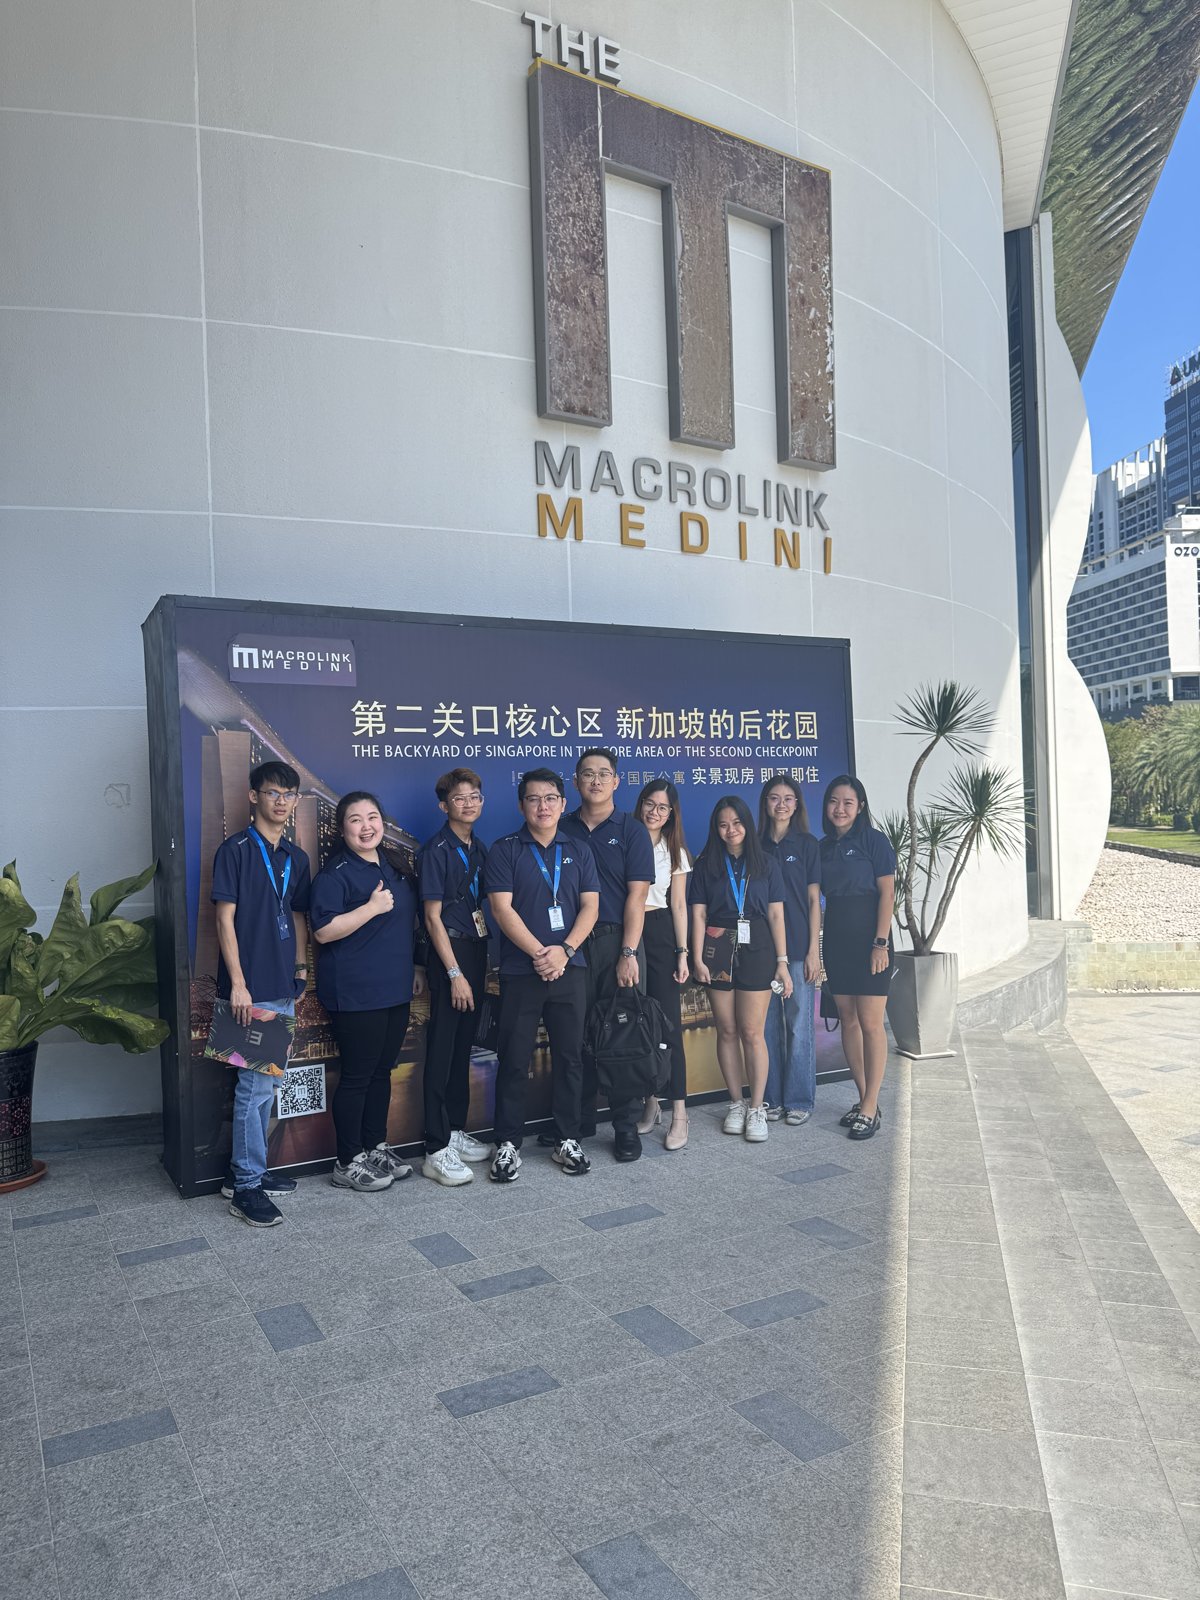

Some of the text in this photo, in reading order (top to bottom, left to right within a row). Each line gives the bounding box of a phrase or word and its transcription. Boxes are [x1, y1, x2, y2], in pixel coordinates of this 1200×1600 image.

[521, 11, 621, 86] THE
[535, 440, 830, 531] MACROLINK
[536, 493, 832, 575] MEDINI
[1174, 546, 1200, 557] OZO
[261, 649, 351, 663] MACROLINK
[262, 659, 352, 673] MEDINI
[350, 700, 818, 741] 第二关口核心区 新加坡的后花园
[351, 744, 380, 758] THE
[384, 744, 460, 758] BACKYARD
[464, 745, 482, 758] OF
[485, 744, 556, 758] SINGAPORE
[560, 745, 573, 758] IN
[602, 745, 632, 758] ORE
[635, 746, 664, 758] AREA
[667, 746, 682, 758] OF
[685, 746, 706, 758] THE
[709, 746, 752, 758] SECOND
[755, 746, 818, 758] CHECKPOINT
[692, 767, 754, 785] 实景现房
